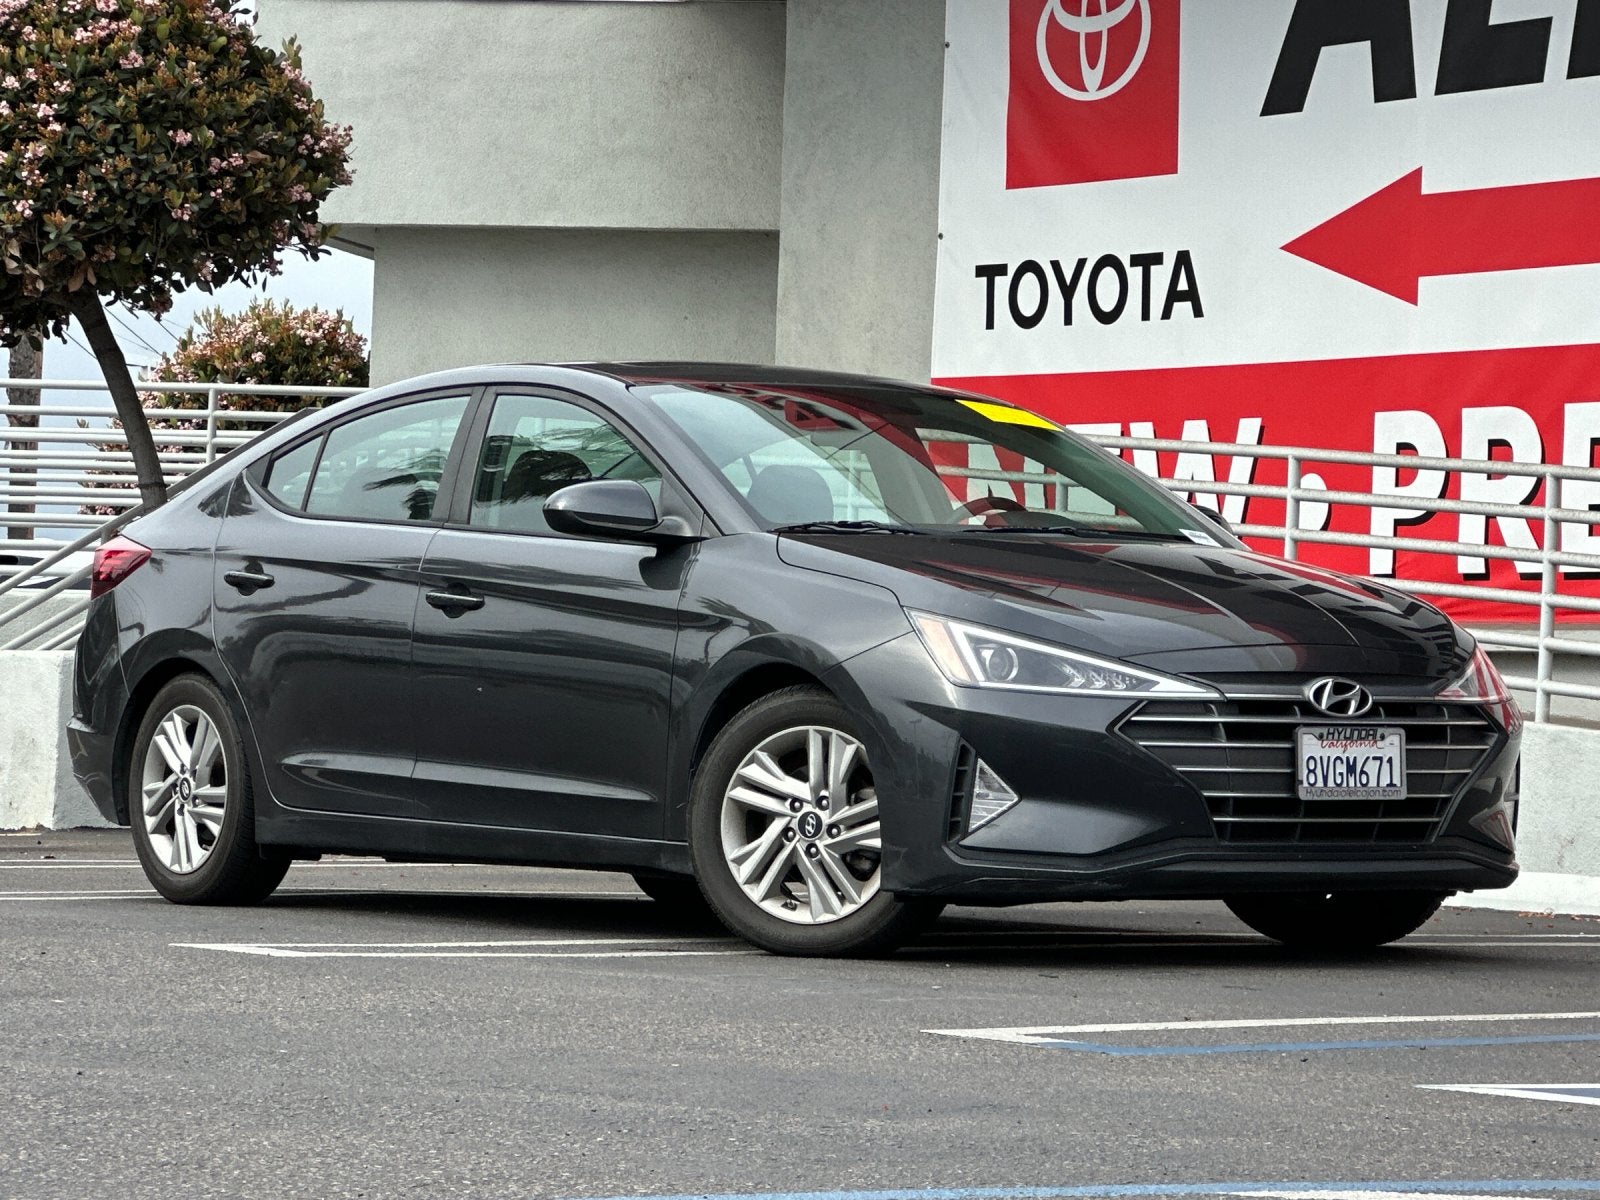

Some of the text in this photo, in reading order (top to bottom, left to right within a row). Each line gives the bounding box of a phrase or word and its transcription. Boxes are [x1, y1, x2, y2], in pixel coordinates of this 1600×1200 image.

[975, 250, 1204, 330] TOYOTA
[1326, 728, 1379, 740] HYUNDAI
[1306, 755, 1397, 787] 8VGM671
